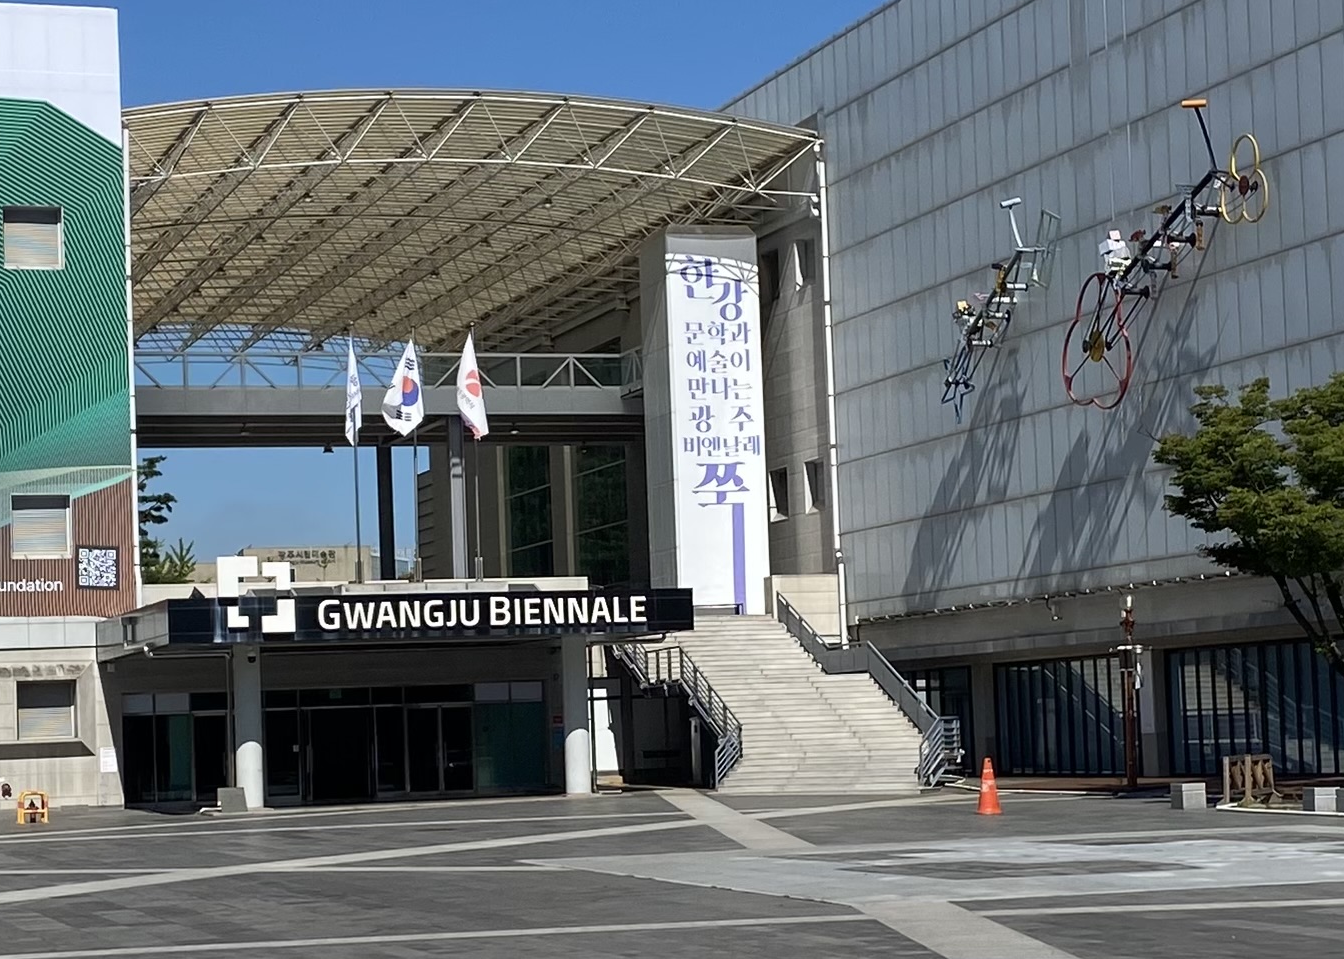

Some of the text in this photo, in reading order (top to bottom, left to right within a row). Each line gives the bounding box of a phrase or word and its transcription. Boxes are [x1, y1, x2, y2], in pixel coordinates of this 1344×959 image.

[685, 321, 752, 346] 문학과
[686, 349, 750, 373] 예술이
[688, 377, 752, 400] 만나는
[683, 435, 760, 457] 비엔날레
[317, 594, 647, 630] GWANGJU BIENNALE
